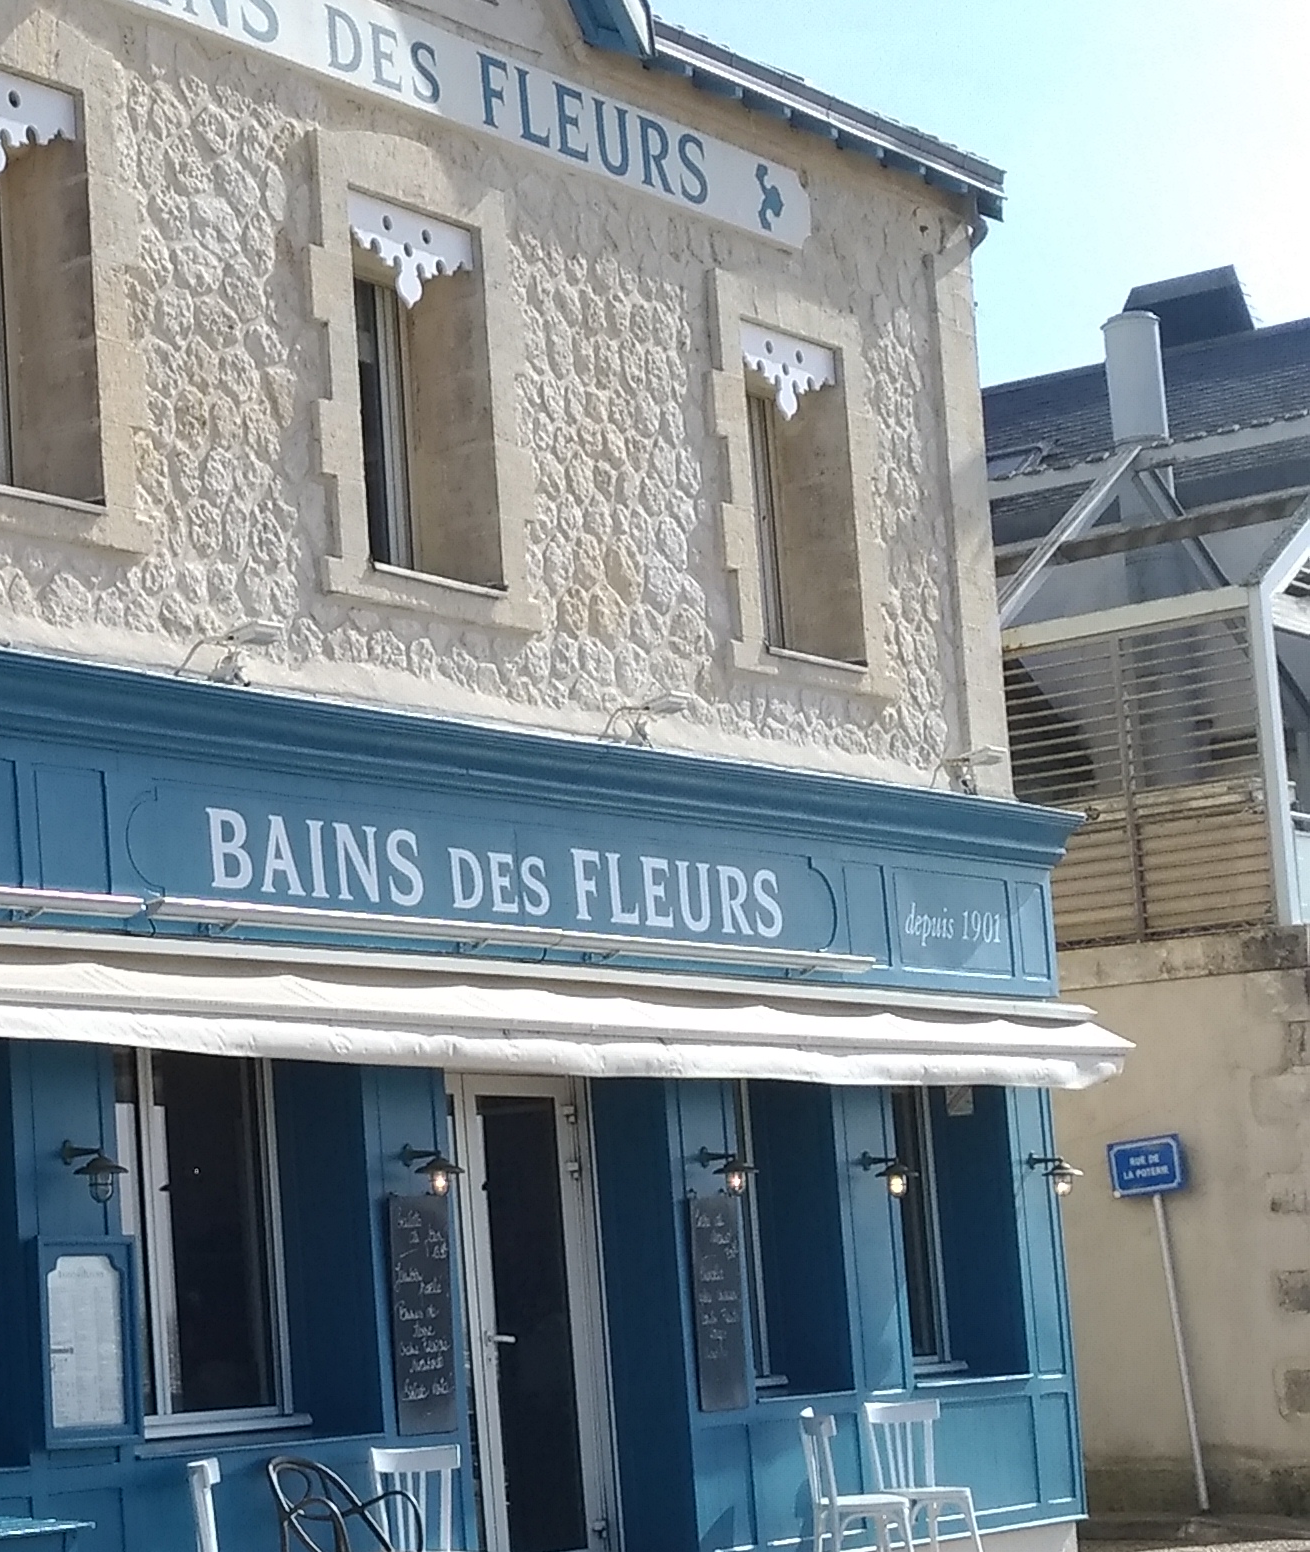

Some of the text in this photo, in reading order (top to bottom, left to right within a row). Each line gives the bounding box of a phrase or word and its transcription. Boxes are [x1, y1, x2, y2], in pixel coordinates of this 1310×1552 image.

[324, 4, 443, 106] DES
[477, 50, 710, 208] FLEURS
[204, 806, 784, 939] BAINS DES FLEURS
[904, 902, 1001, 947] depuis 1901
[1123, 1170, 1134, 1180] LA
